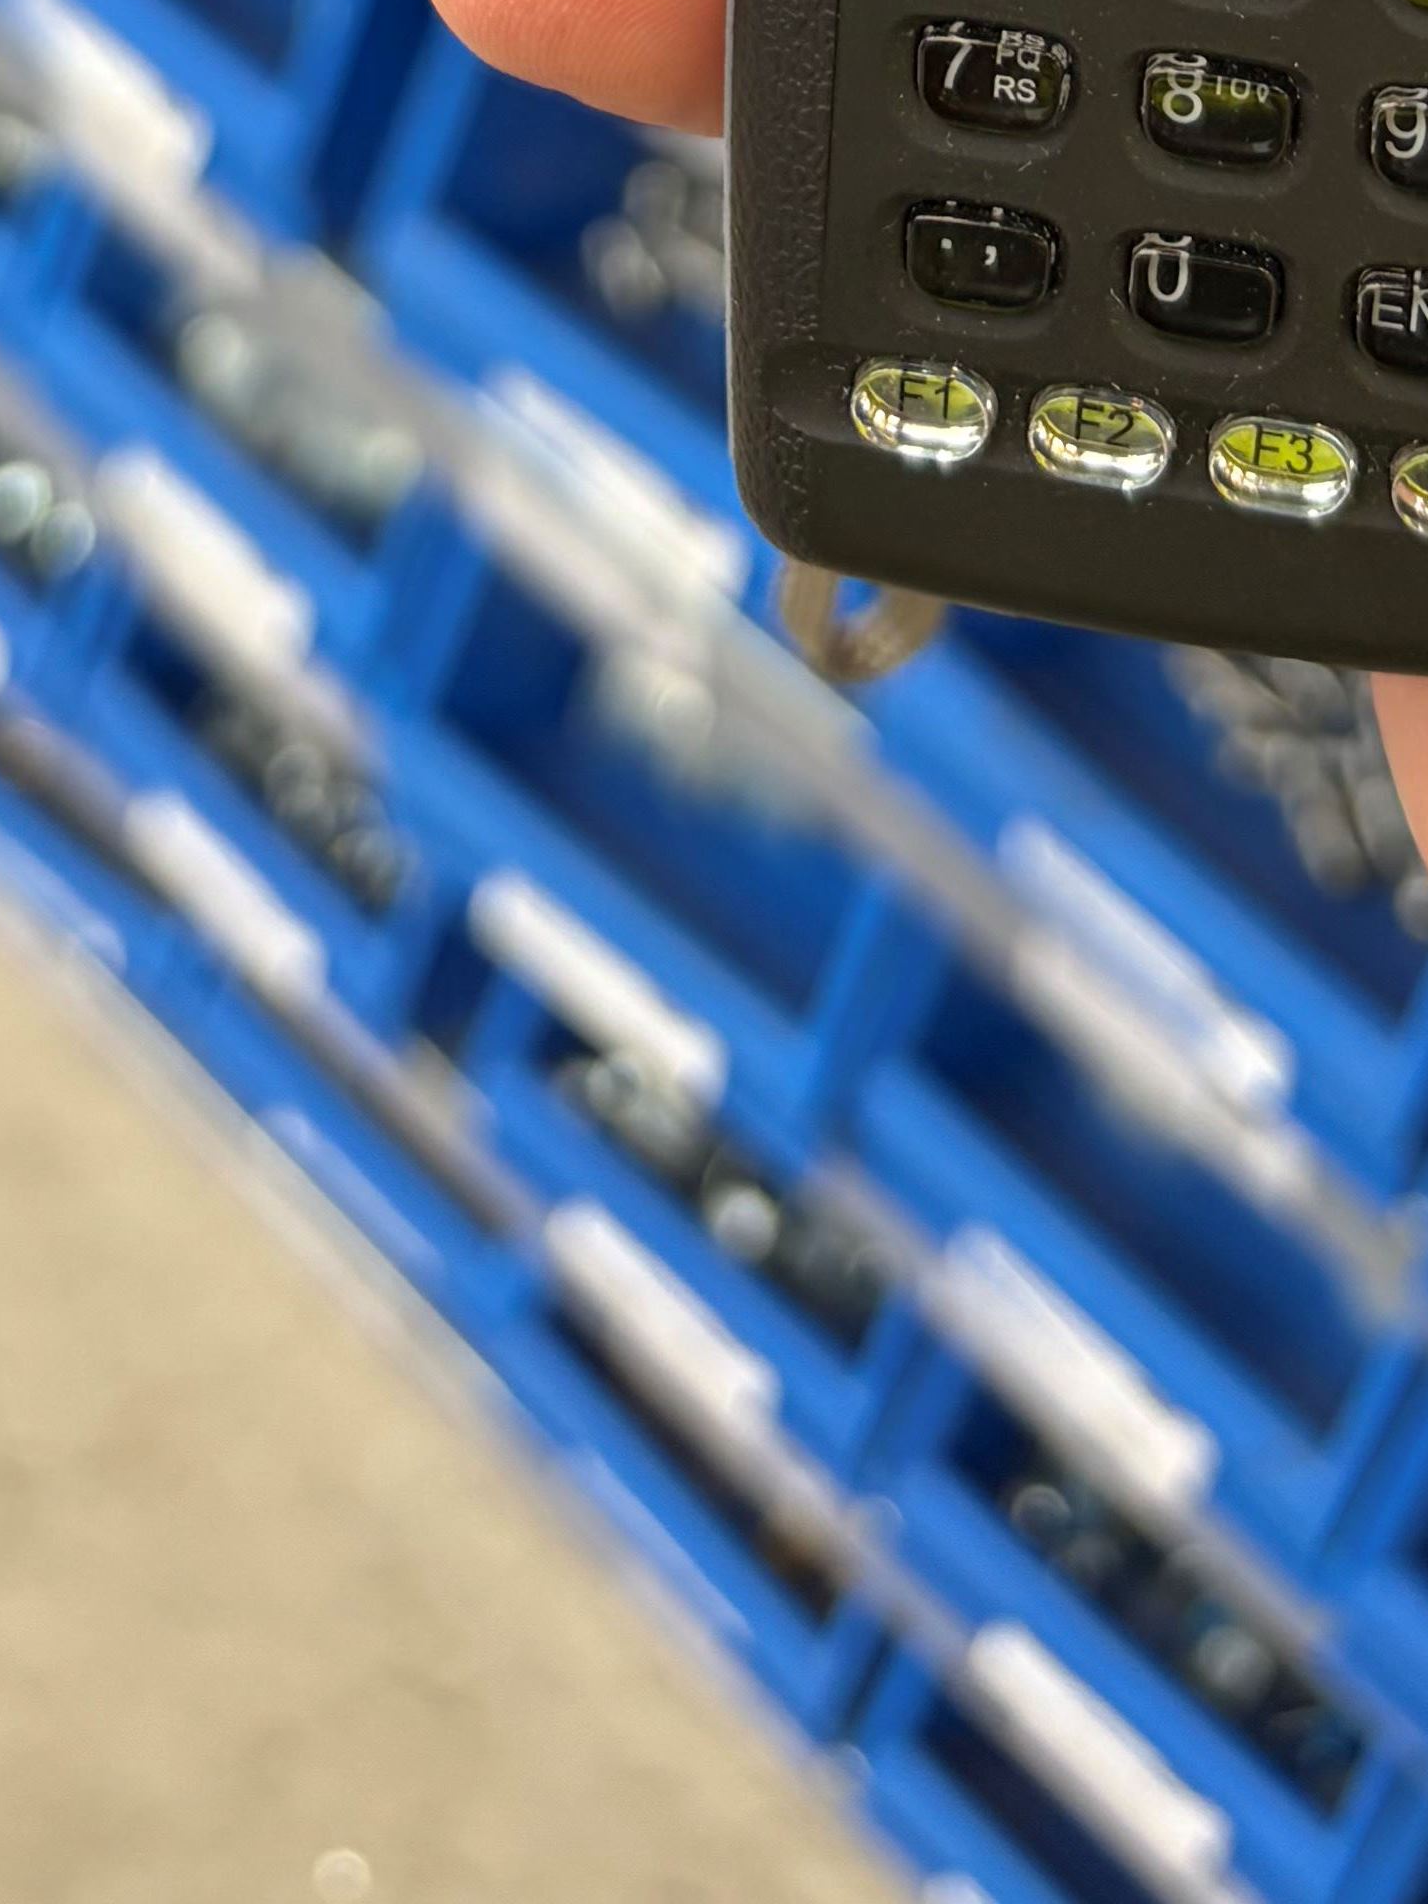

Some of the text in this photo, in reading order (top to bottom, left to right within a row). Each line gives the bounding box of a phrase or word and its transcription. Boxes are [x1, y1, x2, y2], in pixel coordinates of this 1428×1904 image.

[992, 74, 1038, 105] RS
[1161, 66, 1206, 125] 8
[1384, 102, 1428, 160] 9
[898, 370, 957, 427] F1
[1075, 395, 1135, 449] F2
[1252, 424, 1314, 476] F3
